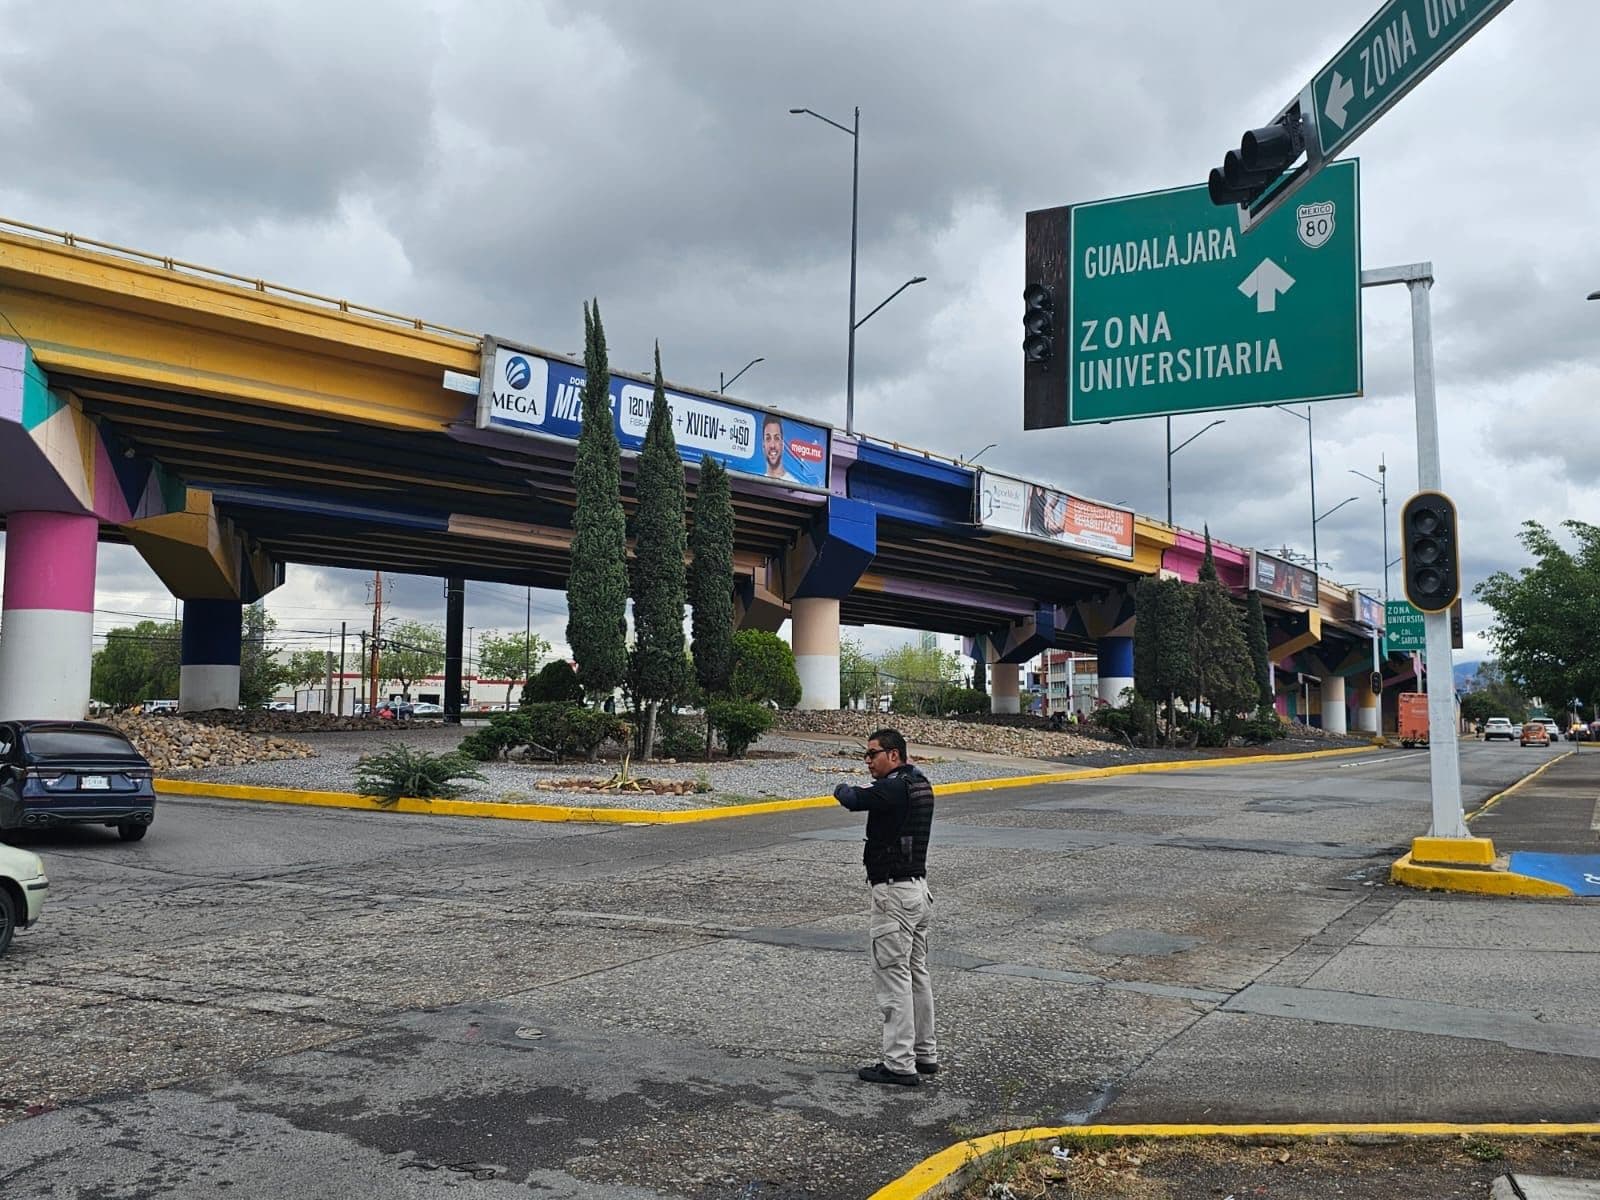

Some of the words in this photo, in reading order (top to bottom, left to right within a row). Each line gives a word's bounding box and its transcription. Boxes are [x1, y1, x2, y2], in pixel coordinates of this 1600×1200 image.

[1360, 10, 1417, 100] ZONA
[1306, 219, 1328, 237] 80
[1084, 226, 1237, 279] GUADALAJARA
[1080, 311, 1172, 352] ZONA
[1079, 338, 1283, 393] UNIVERSITARIA
[492, 391, 538, 416] MEGA
[628, 396, 644, 417] 120
[729, 425, 750, 446] $450
[1387, 606, 1410, 615] ZONA
